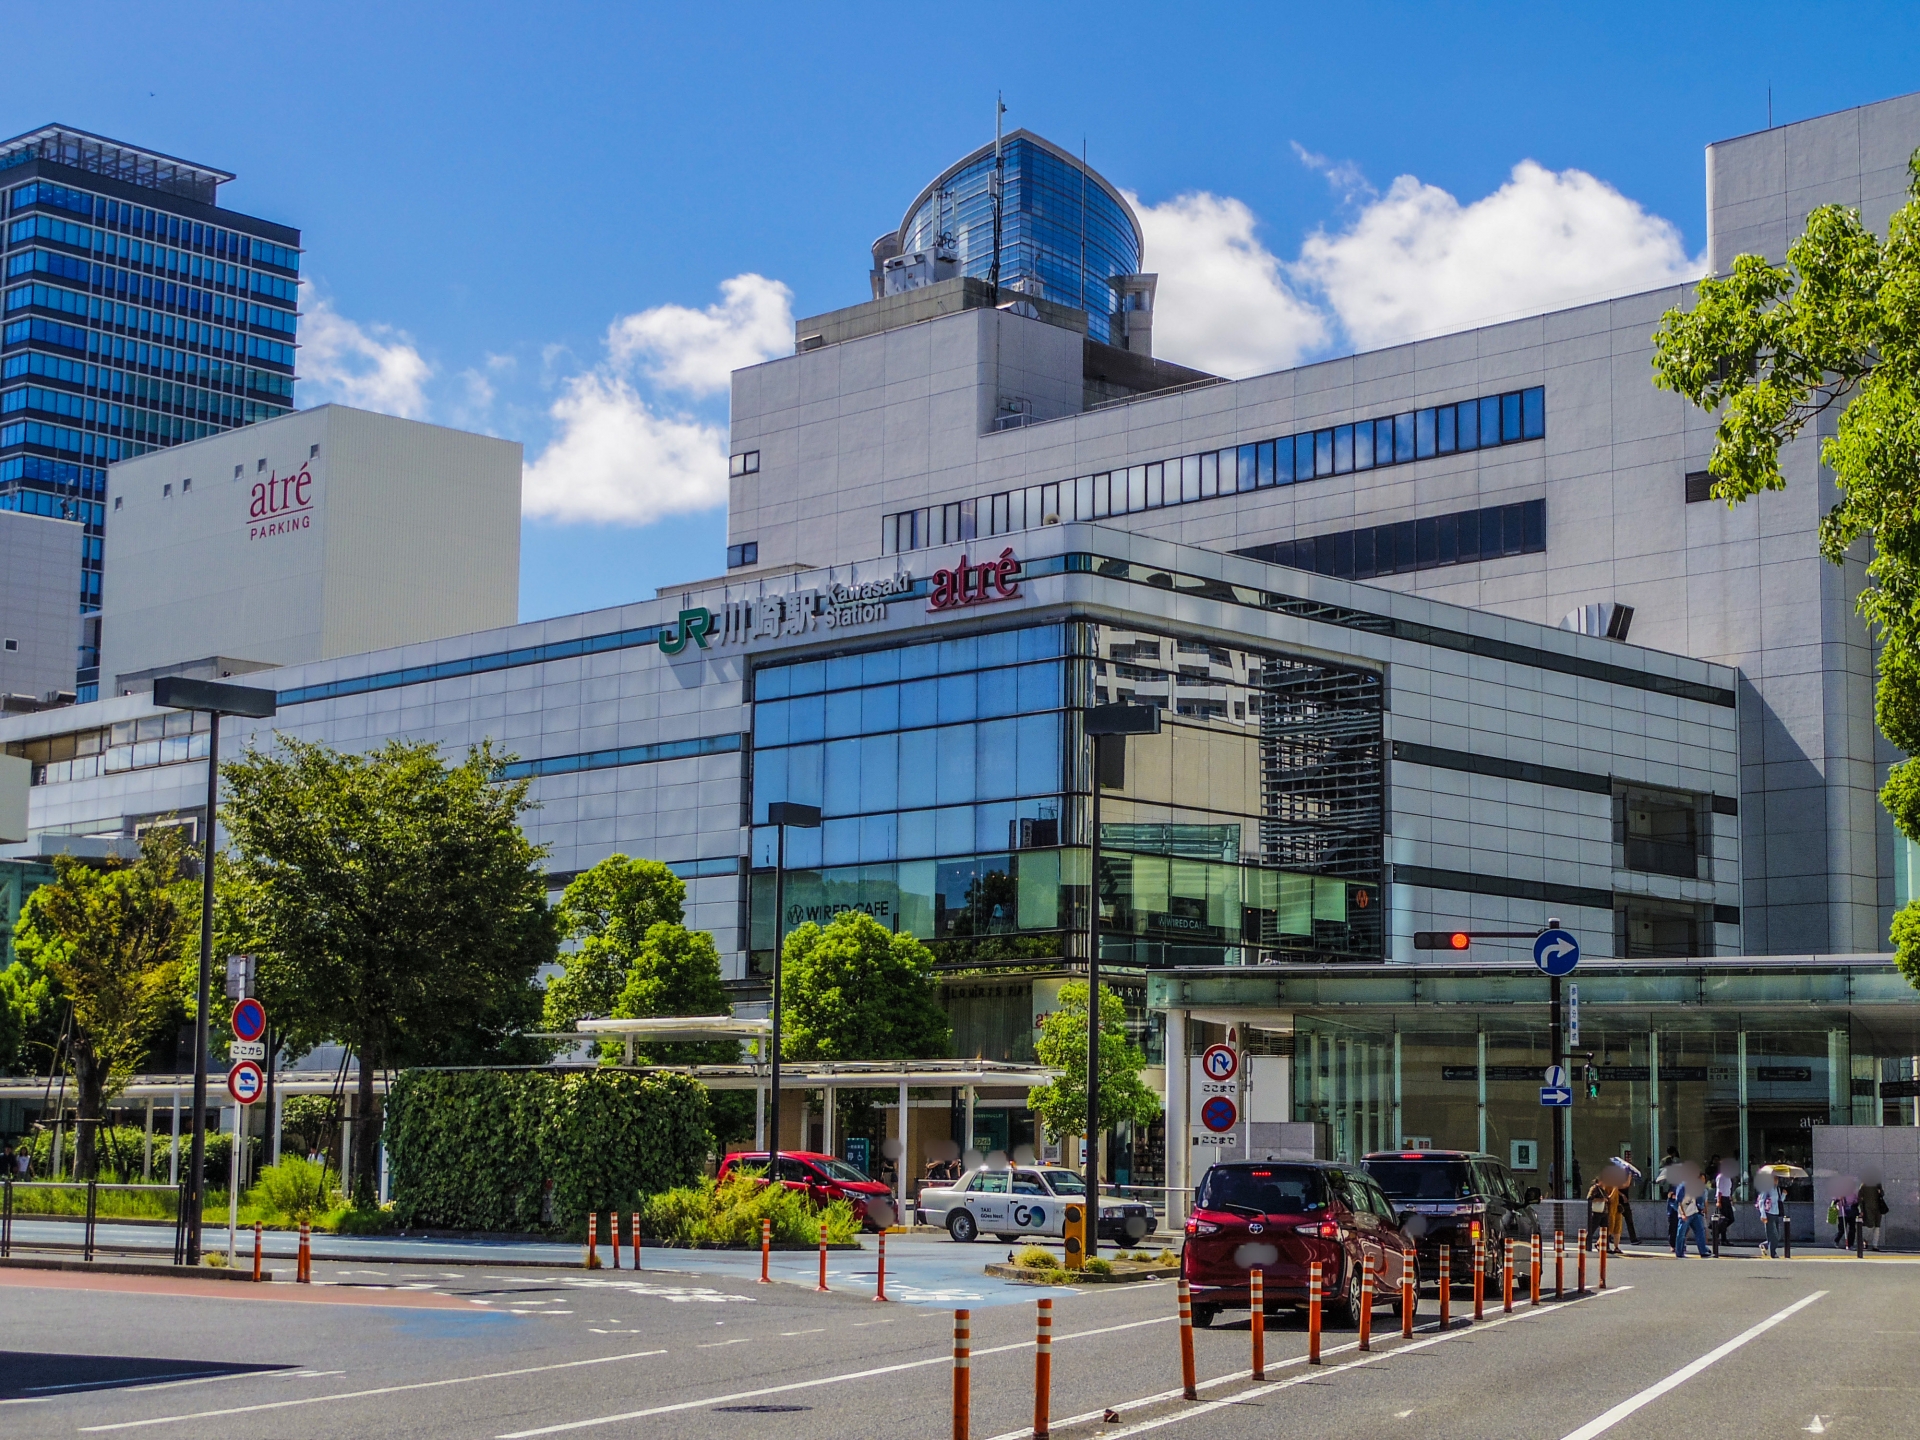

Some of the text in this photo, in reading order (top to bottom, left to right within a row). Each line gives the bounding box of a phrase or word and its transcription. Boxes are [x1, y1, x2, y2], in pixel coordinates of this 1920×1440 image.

[250, 461, 312, 518] atré
[250, 515, 310, 541] PARKING
[825, 573, 910, 605] Kawasaki
[930, 547, 1020, 608] atré
[659, 589, 817, 654] JR 川崎駅
[823, 603, 887, 629] Station
[1167, 917, 1188, 929] WIRED
[233, 1045, 263, 1056] ここから
[1203, 1084, 1236, 1093] ここまで
[1202, 1136, 1235, 1145] ここまで
